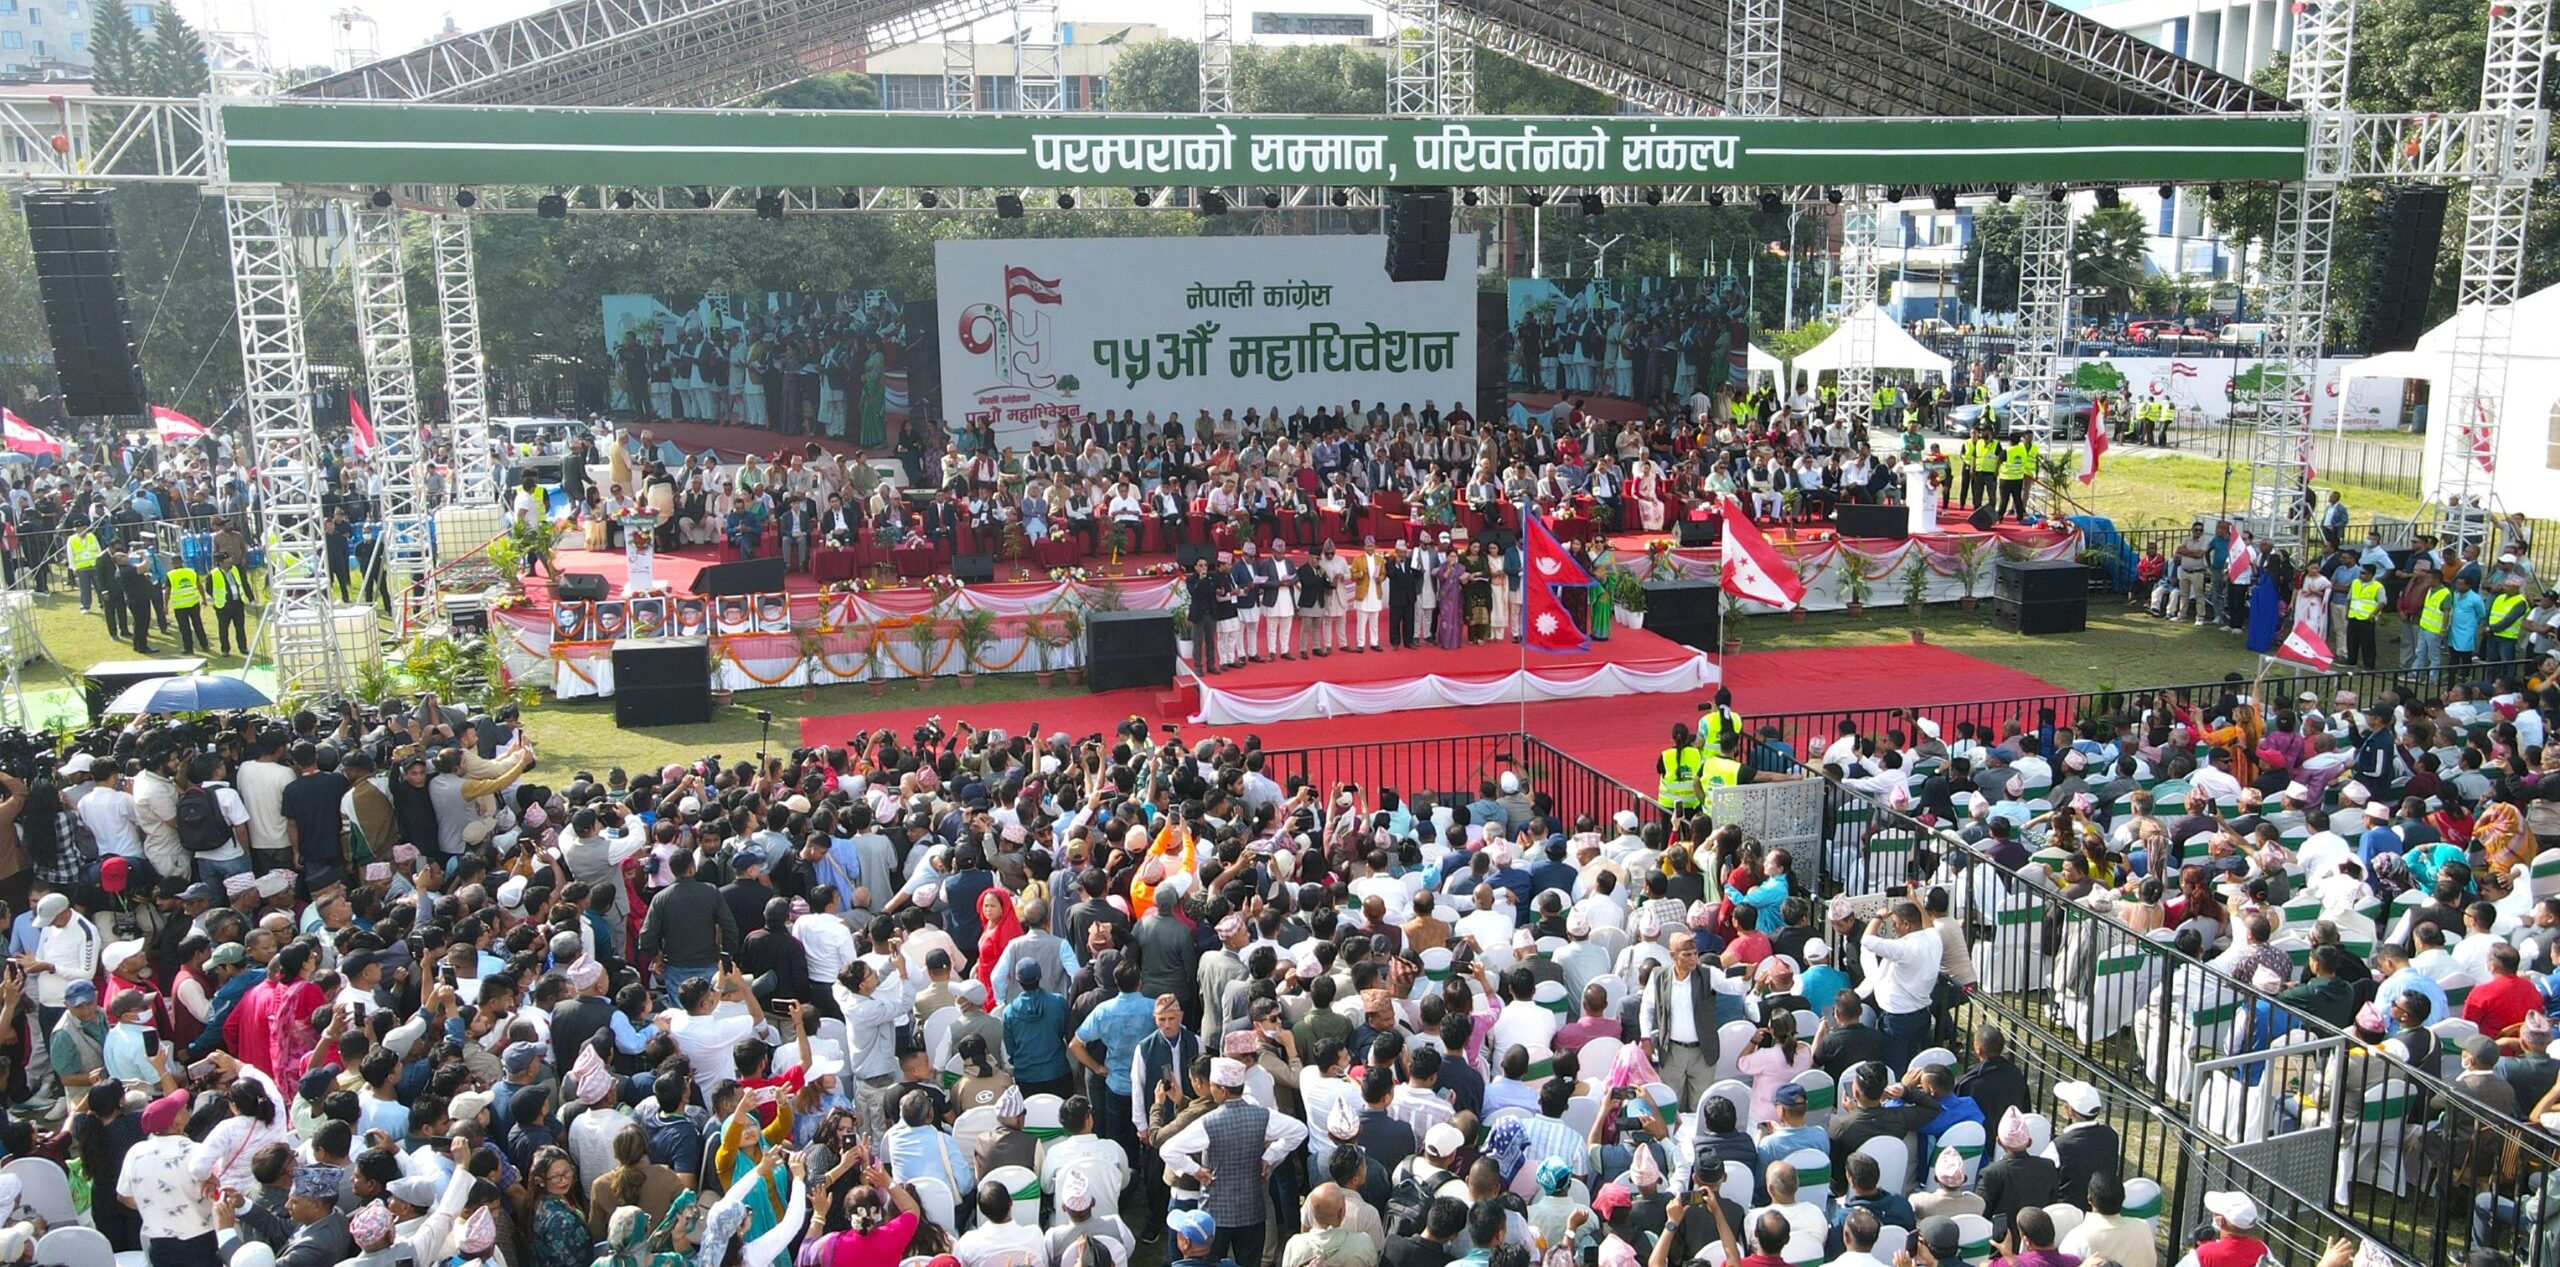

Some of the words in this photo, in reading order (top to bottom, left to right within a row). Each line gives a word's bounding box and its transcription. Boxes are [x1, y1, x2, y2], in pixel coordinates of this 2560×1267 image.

[1031, 123, 1237, 173] परम्पराको
[1251, 134, 1397, 182] सम्मान,
[1413, 124, 1611, 172] परिवर्तनको
[1622, 123, 1740, 172] संकल्प
[1186, 280, 1255, 310] नेपाली
[1263, 279, 1334, 310] कांग्रेस
[1229, 321, 1460, 382] महाधिवेशन
[1006, 402, 1080, 424] महाधिवेशन
